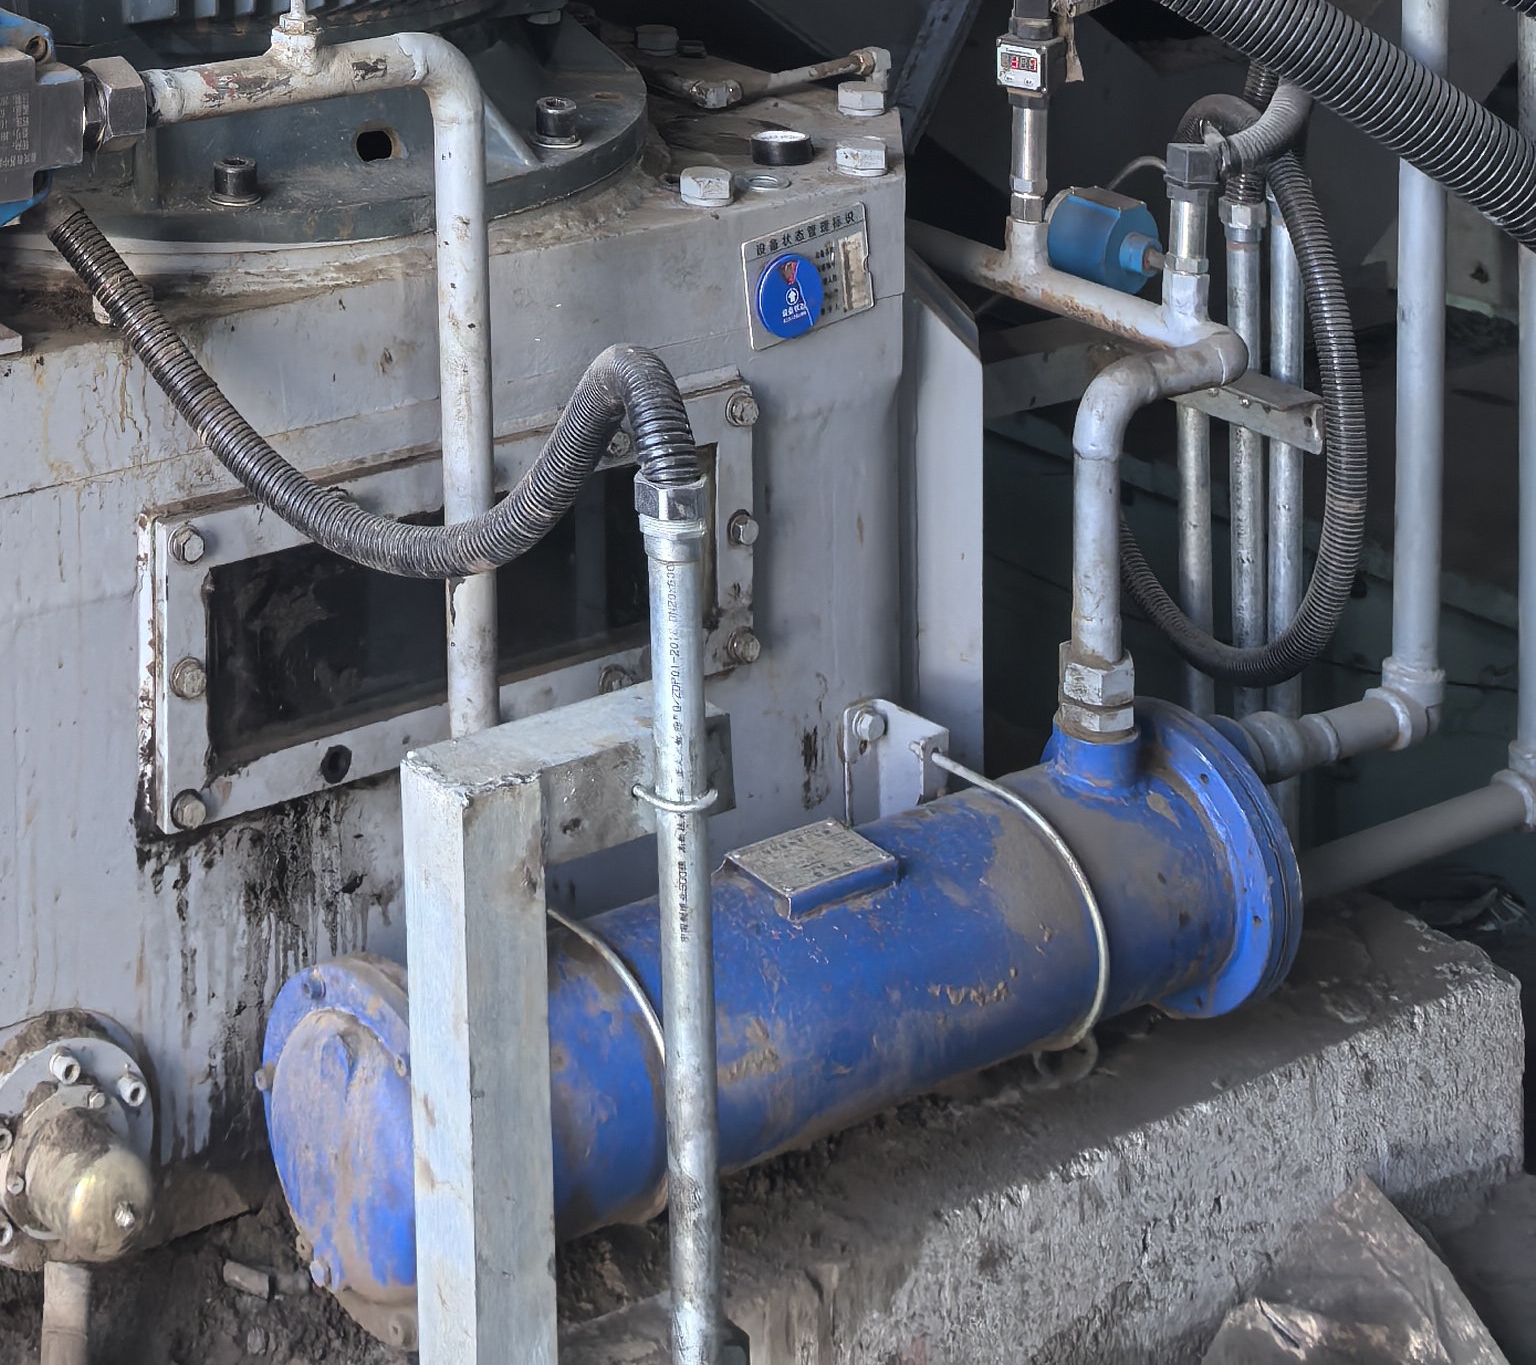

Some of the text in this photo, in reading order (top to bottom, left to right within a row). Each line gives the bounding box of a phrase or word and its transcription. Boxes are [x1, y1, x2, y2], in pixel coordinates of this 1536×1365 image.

[756, 211, 855, 256] 设备状态管理标识
